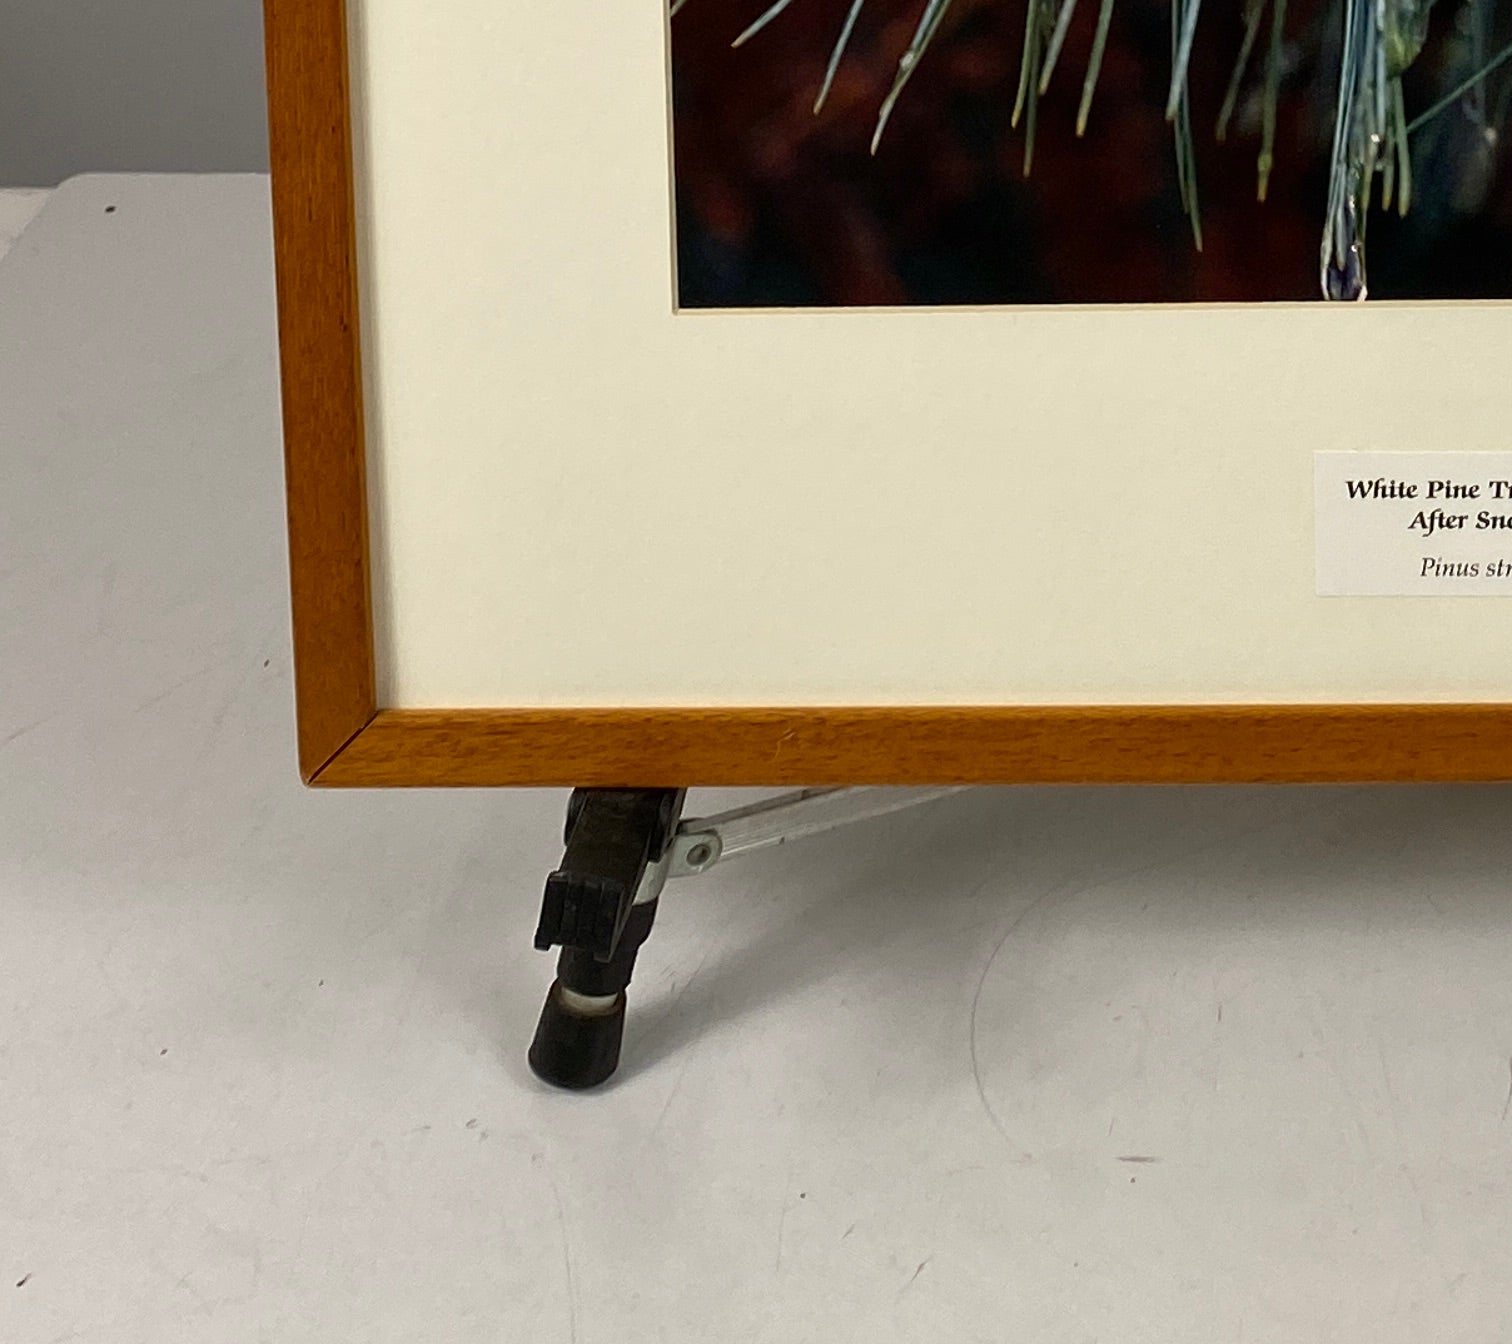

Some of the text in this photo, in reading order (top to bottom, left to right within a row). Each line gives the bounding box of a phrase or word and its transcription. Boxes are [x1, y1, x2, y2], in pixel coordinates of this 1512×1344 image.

[1346, 477, 1419, 500] White
[1425, 479, 1481, 500] Pine
[1407, 508, 1469, 538] After
[1420, 556, 1480, 578] Pinus
